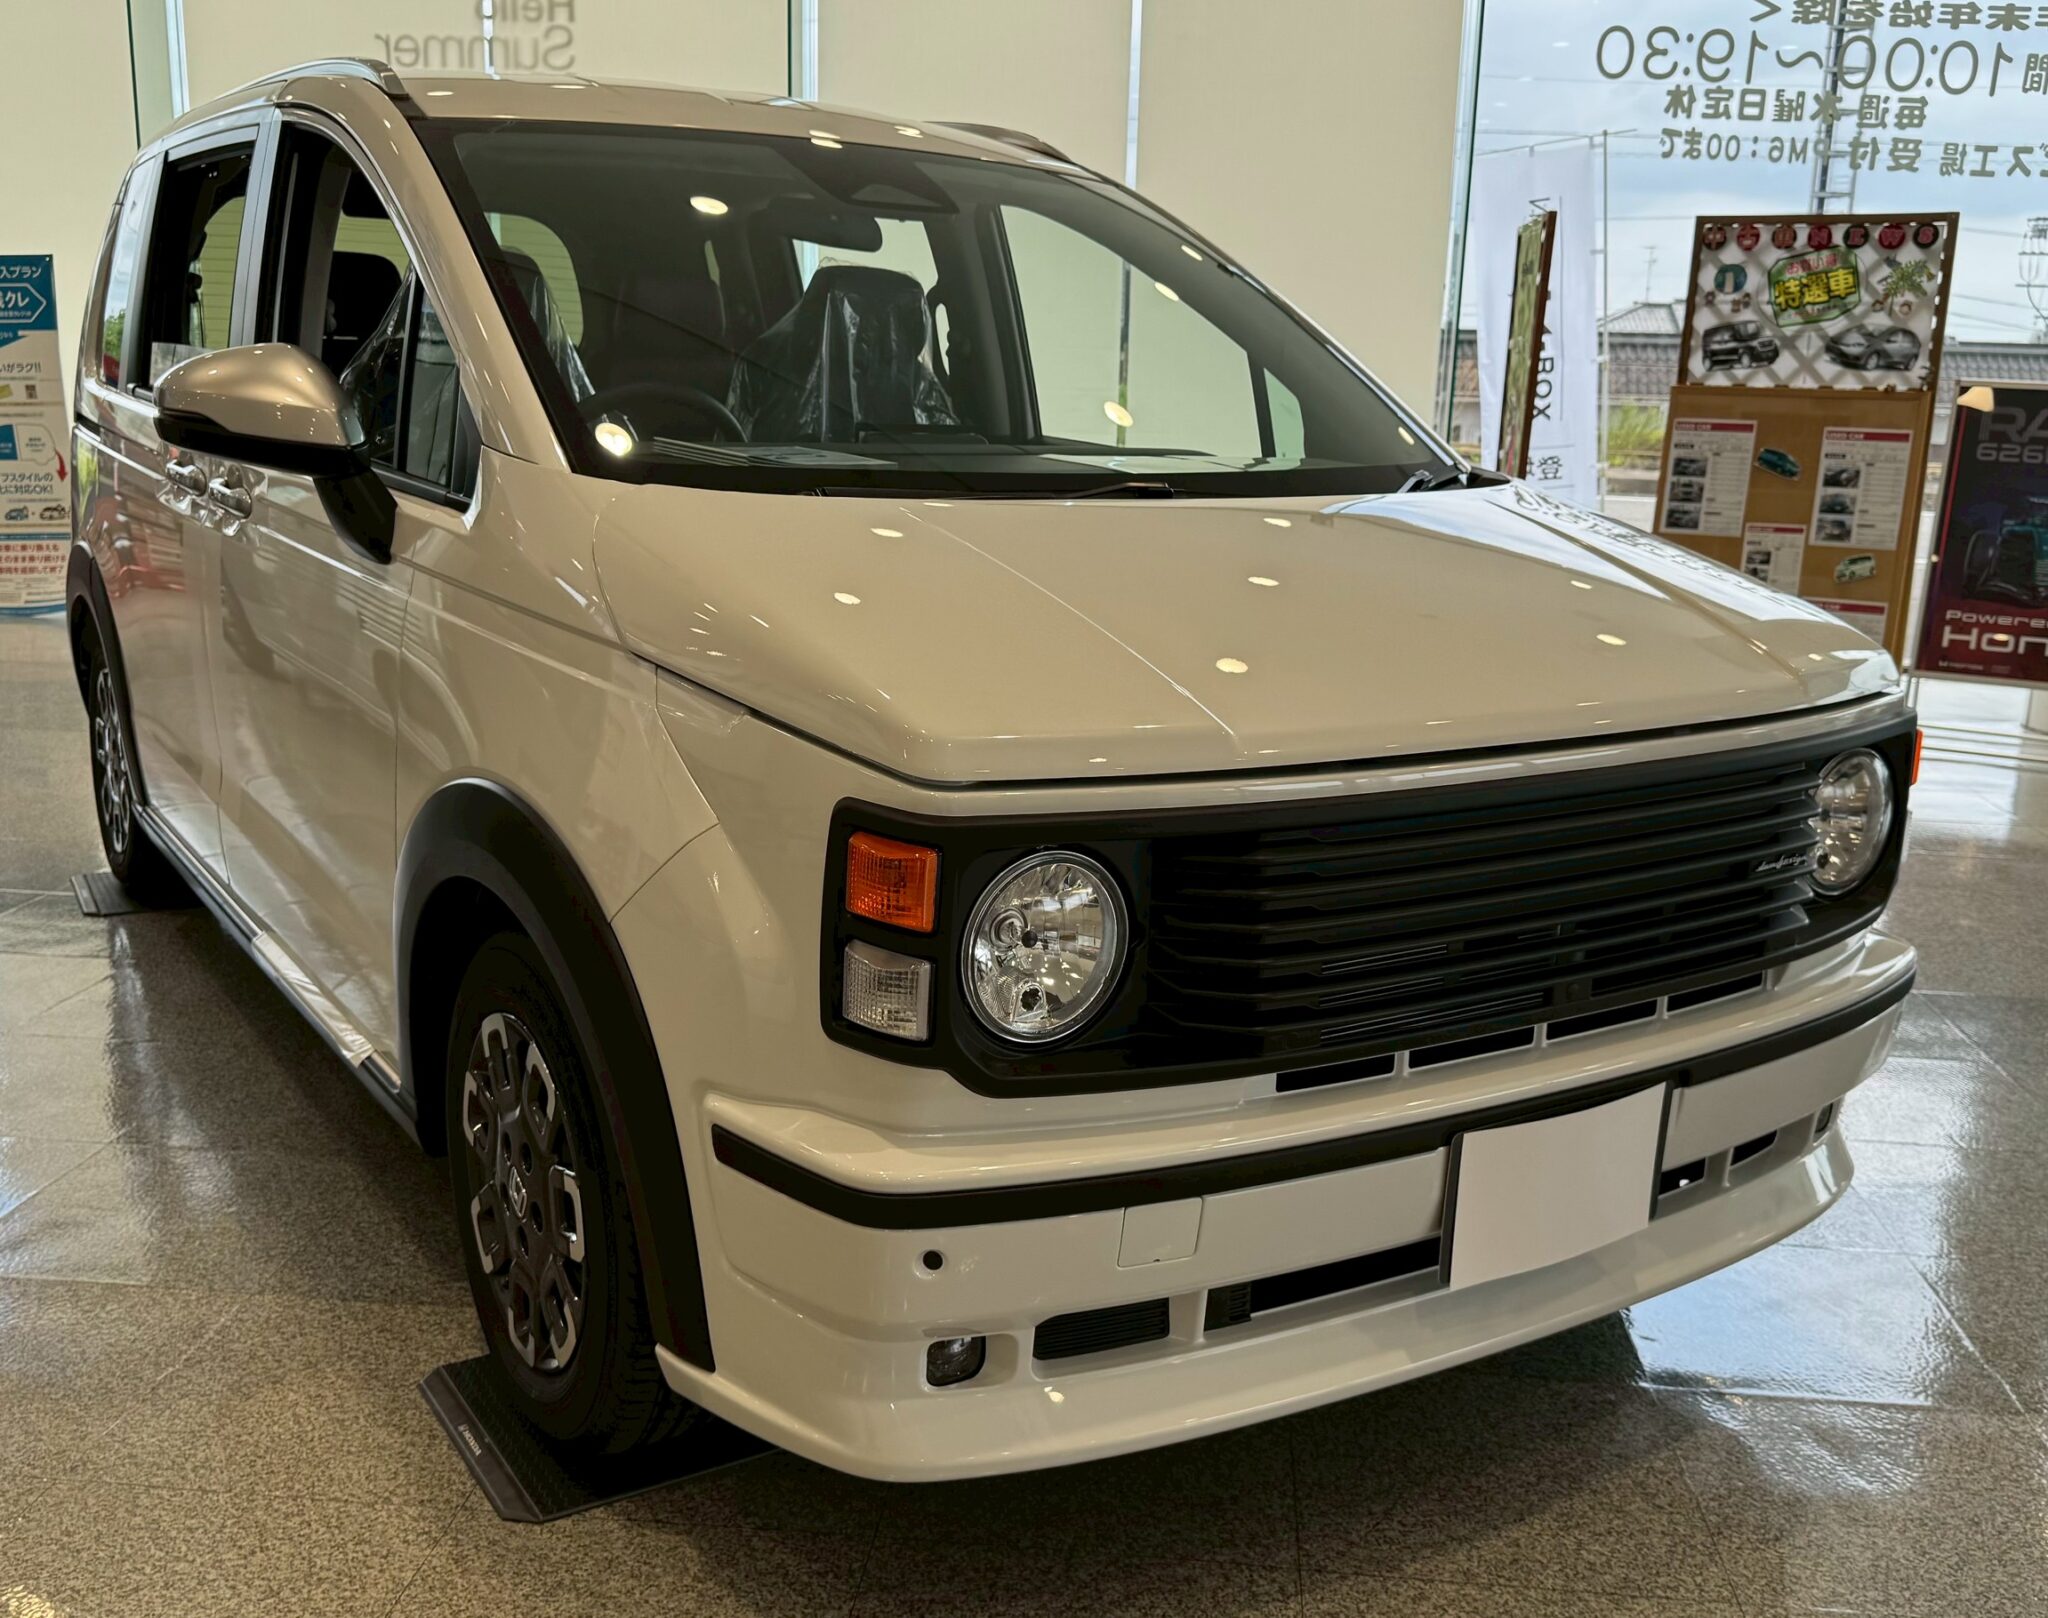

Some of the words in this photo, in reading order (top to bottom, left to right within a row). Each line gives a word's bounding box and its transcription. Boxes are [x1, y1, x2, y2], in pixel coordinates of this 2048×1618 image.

[1775, 268, 1857, 312] 特選車
[1976, 442, 2048, 464] 626
[1945, 609, 2048, 629] Powere
